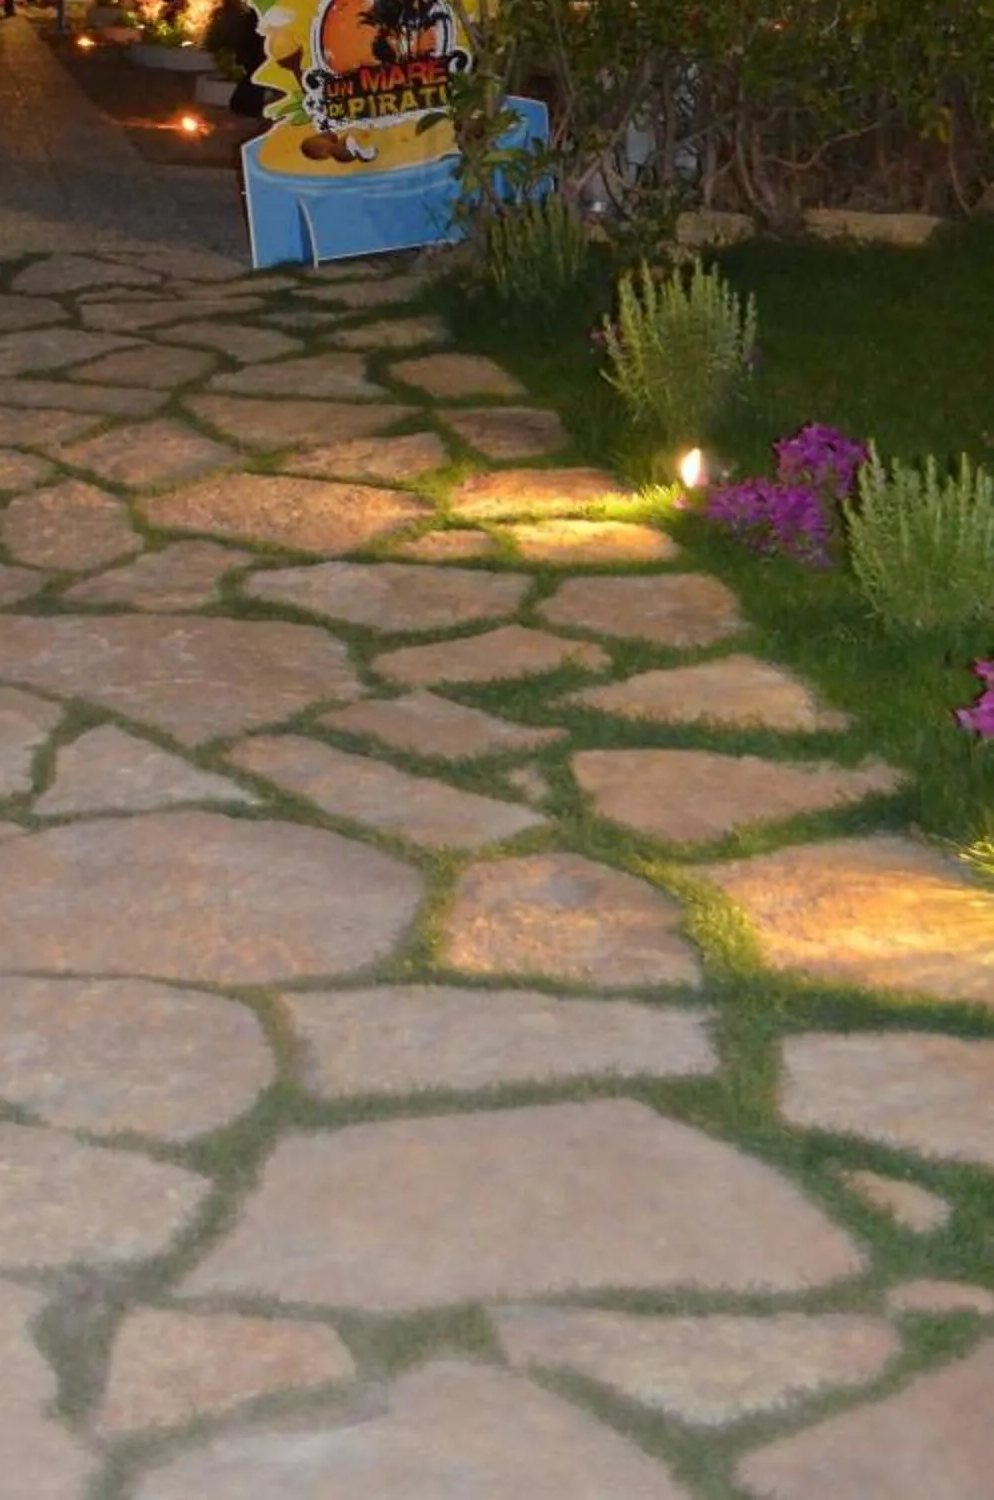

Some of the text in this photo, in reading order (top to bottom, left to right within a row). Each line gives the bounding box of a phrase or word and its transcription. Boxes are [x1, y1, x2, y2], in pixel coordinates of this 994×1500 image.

[326, 62, 447, 98] UN MARE
[347, 85, 448, 119] PIRATI
